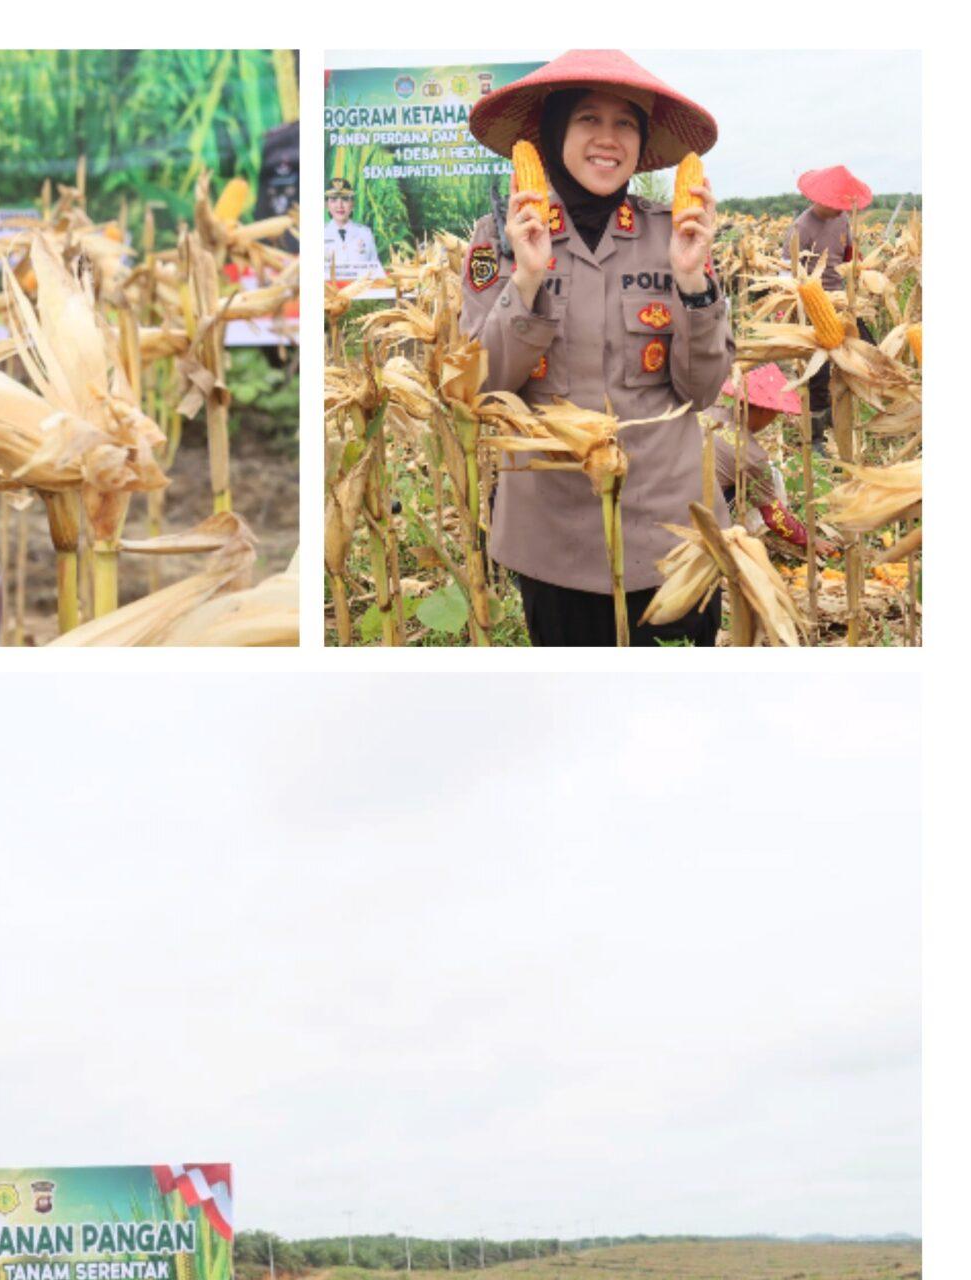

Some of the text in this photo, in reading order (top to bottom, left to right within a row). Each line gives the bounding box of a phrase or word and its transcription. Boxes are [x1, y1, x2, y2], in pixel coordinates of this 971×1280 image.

[324, 104, 473, 128] ROGRAM KETAHA
[373, 132, 428, 144] PERDANA
[433, 131, 457, 143] DAN
[403, 148, 438, 160] DESA
[494, 162, 514, 175] KAL
[622, 271, 673, 293] POLR
[81, 1221, 195, 1253] PANGAN
[75, 1260, 170, 1280] SERENTAK
